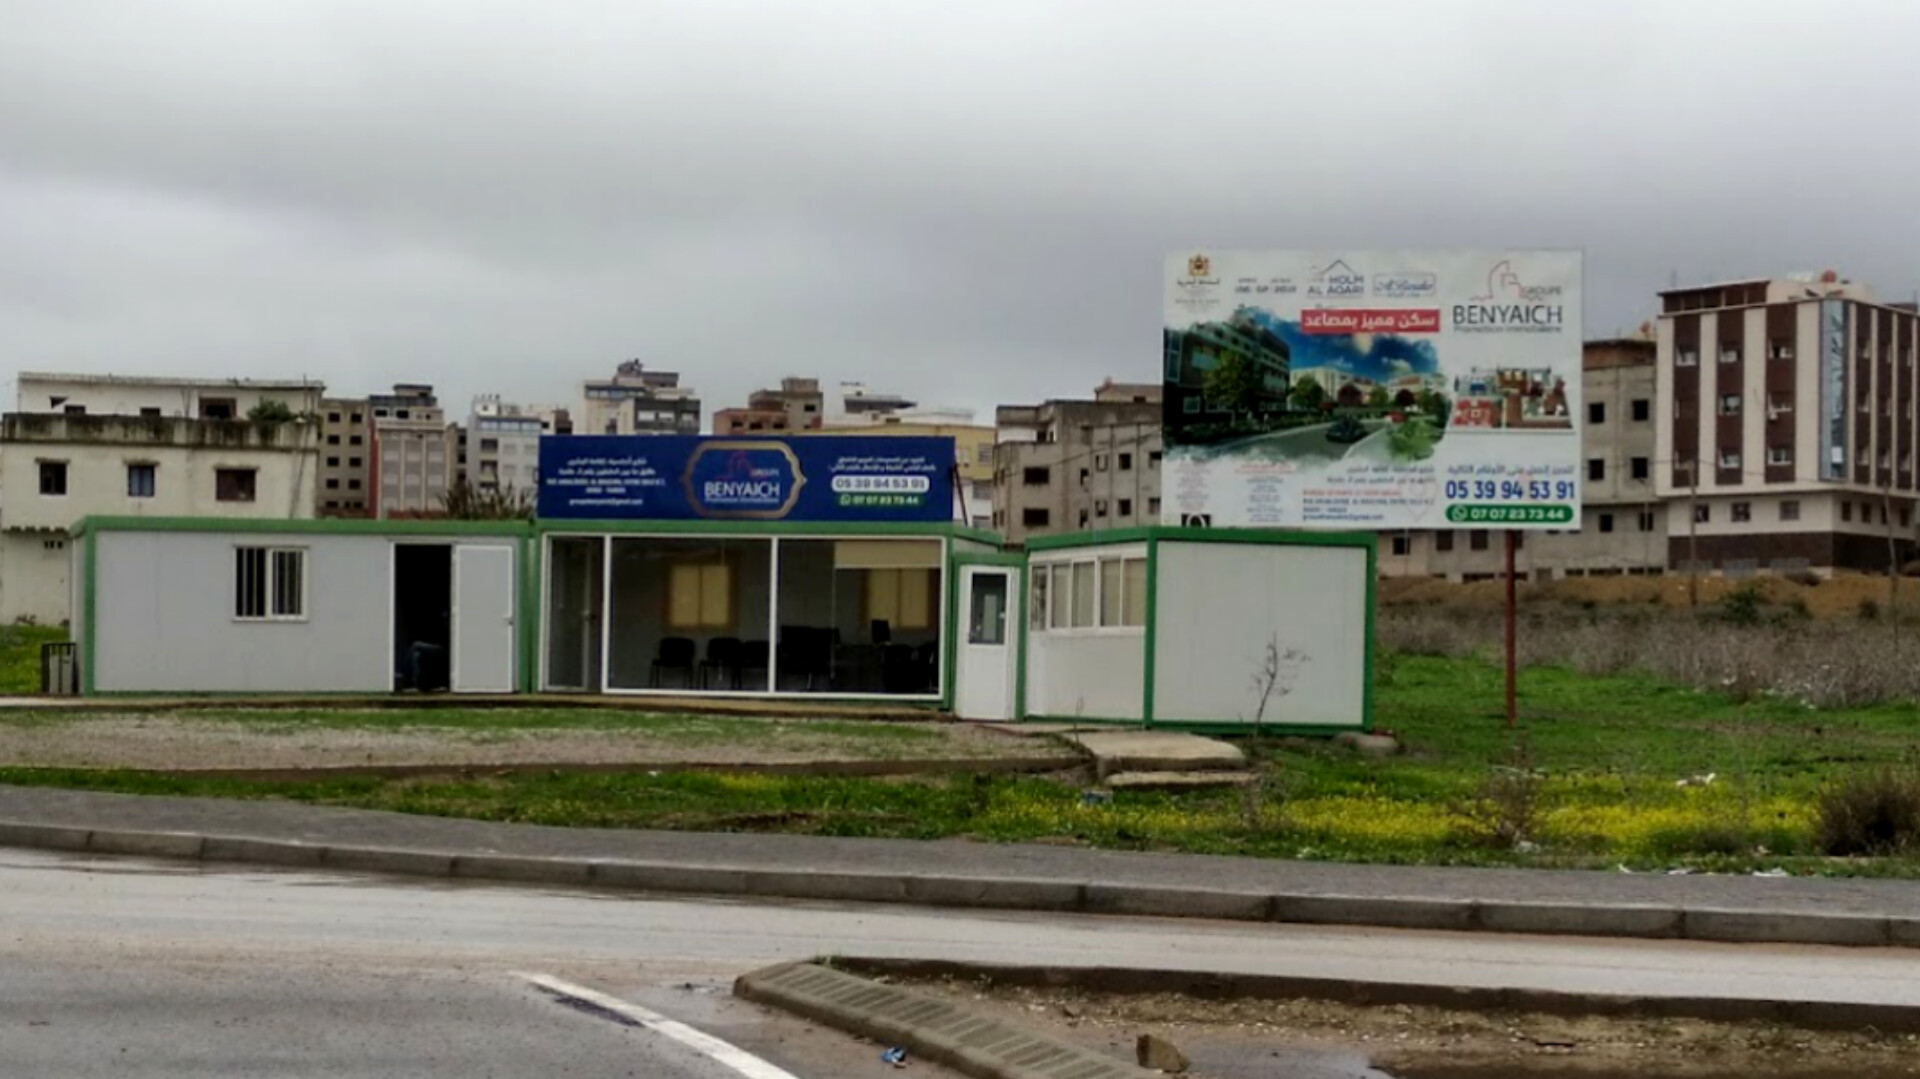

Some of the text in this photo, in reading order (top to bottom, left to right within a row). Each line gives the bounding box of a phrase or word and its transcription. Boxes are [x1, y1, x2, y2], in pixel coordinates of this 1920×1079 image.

[1304, 312, 1436, 330] سكن مميز بمصاعد
[1452, 305, 1562, 324] BENYAICH
[704, 481, 779, 497] BENYAICH
[1445, 480, 1468, 499] 05
[1474, 480, 1496, 499] 39
[1501, 480, 1523, 499] 94
[1529, 480, 1551, 499] 53
[1556, 480, 1575, 499] 91
[1470, 508, 1565, 519] 07 07 23 73 44
